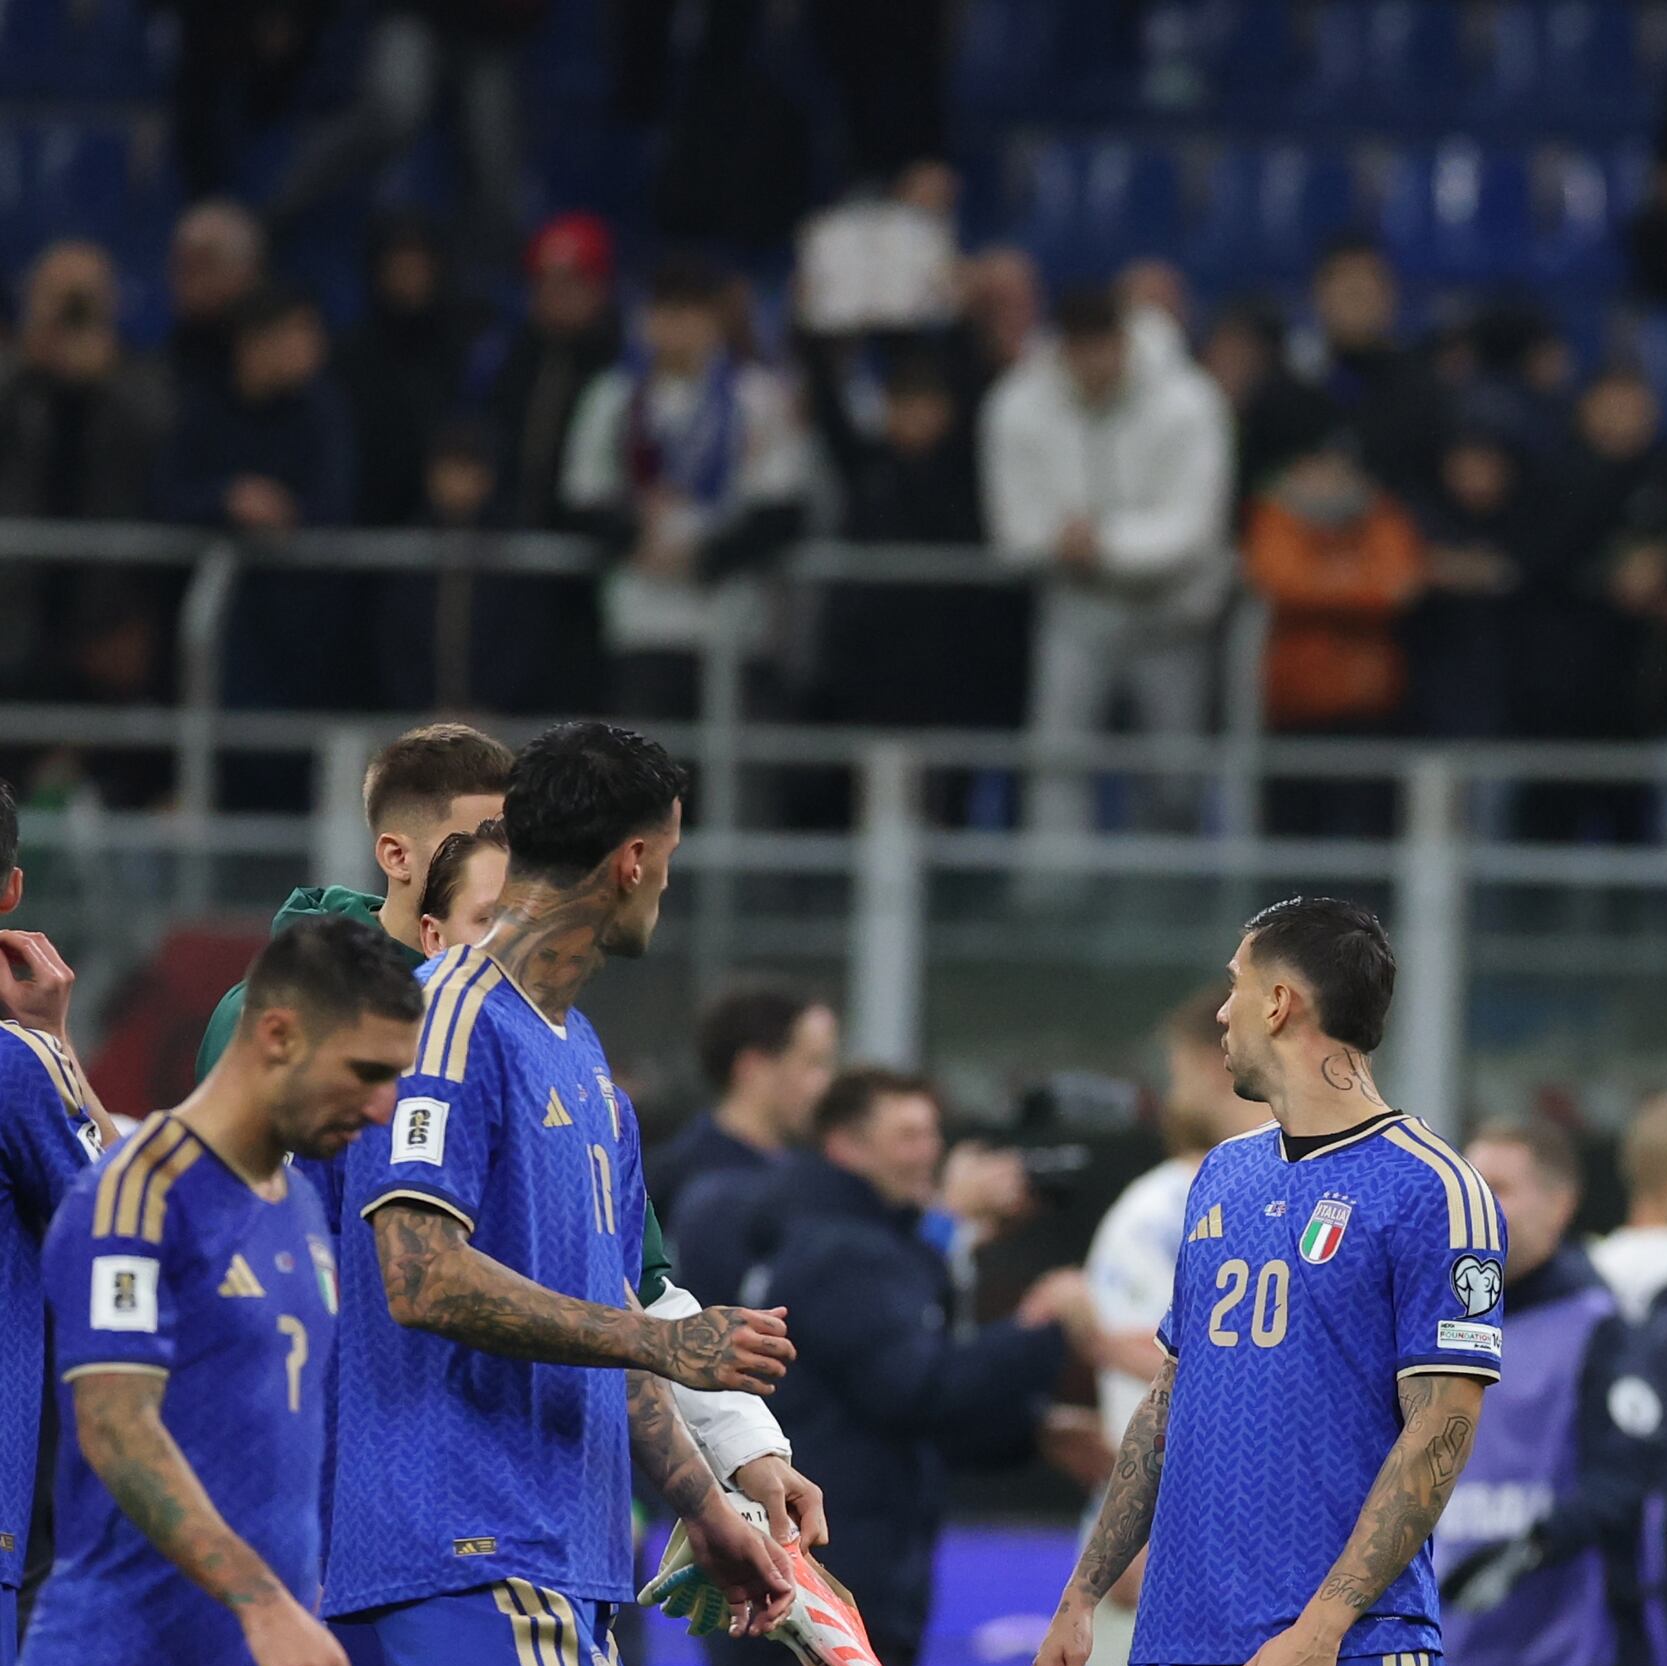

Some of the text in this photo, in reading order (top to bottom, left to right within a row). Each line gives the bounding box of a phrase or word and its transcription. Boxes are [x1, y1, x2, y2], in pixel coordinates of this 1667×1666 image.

[1317, 1204, 1346, 1221] ITALIA
[1209, 1259, 1290, 1348] 20
[1440, 1331, 1492, 1343] FOUNDATION
[277, 1315, 309, 1413] 7
